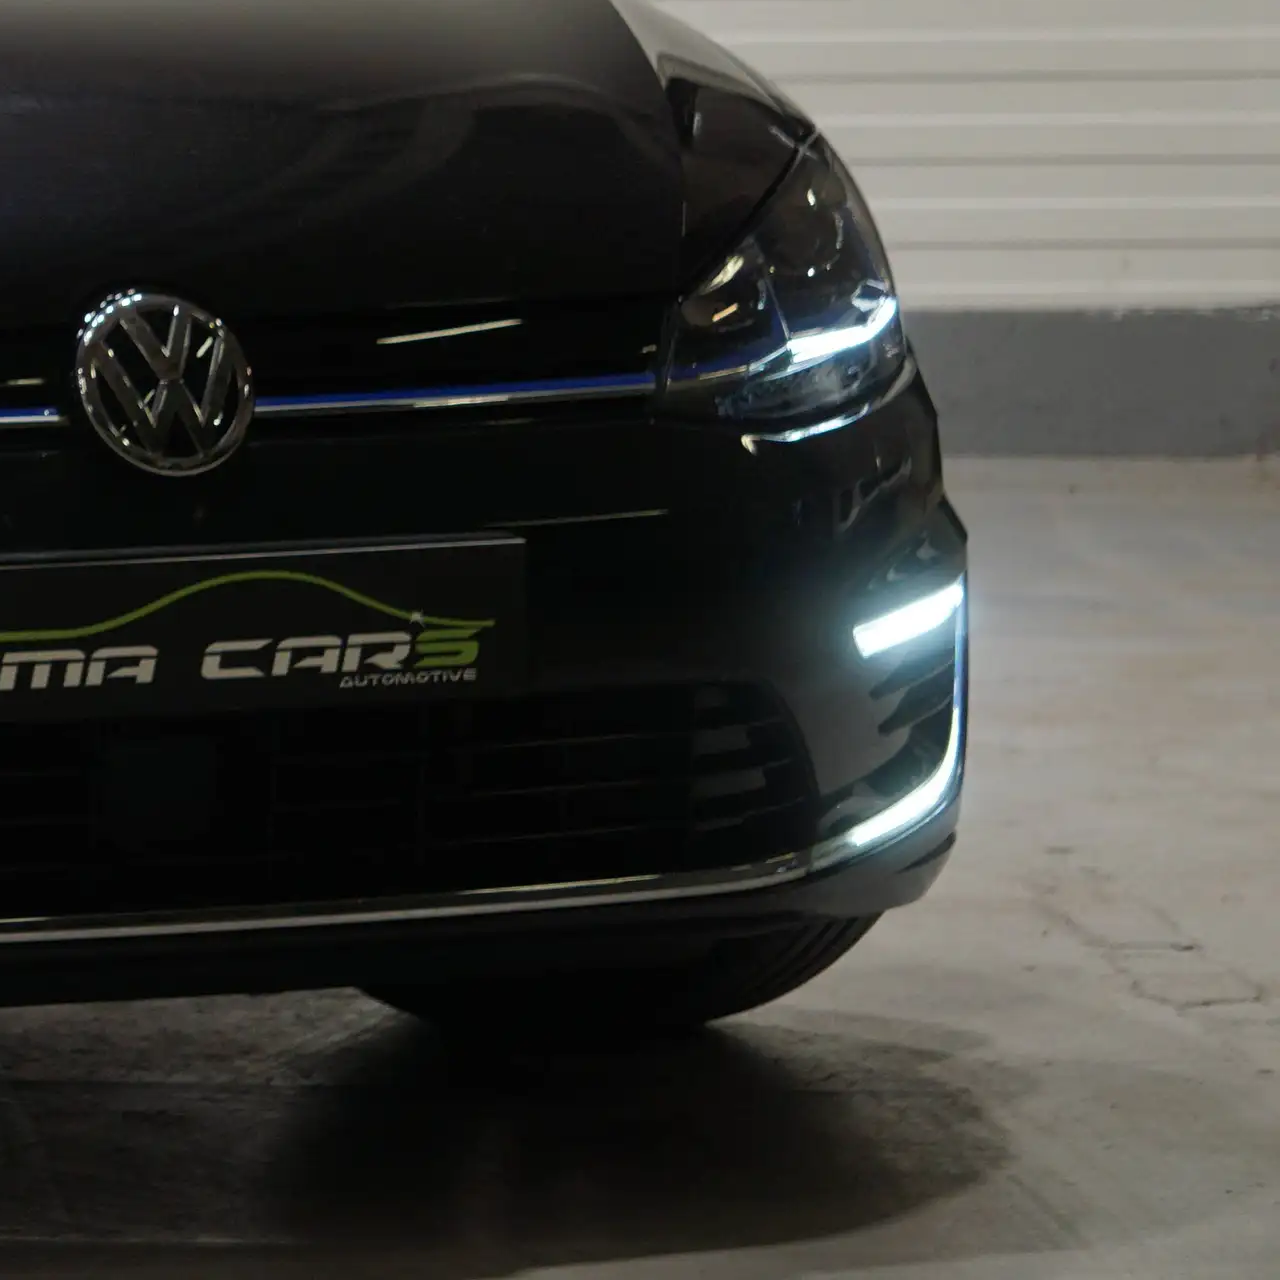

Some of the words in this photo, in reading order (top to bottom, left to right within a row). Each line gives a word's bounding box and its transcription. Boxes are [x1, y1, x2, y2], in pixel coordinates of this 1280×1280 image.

[83, 297, 245, 469] VW
[200, 628, 481, 680] CARS
[339, 667, 478, 688] AUTOMOTIVE
